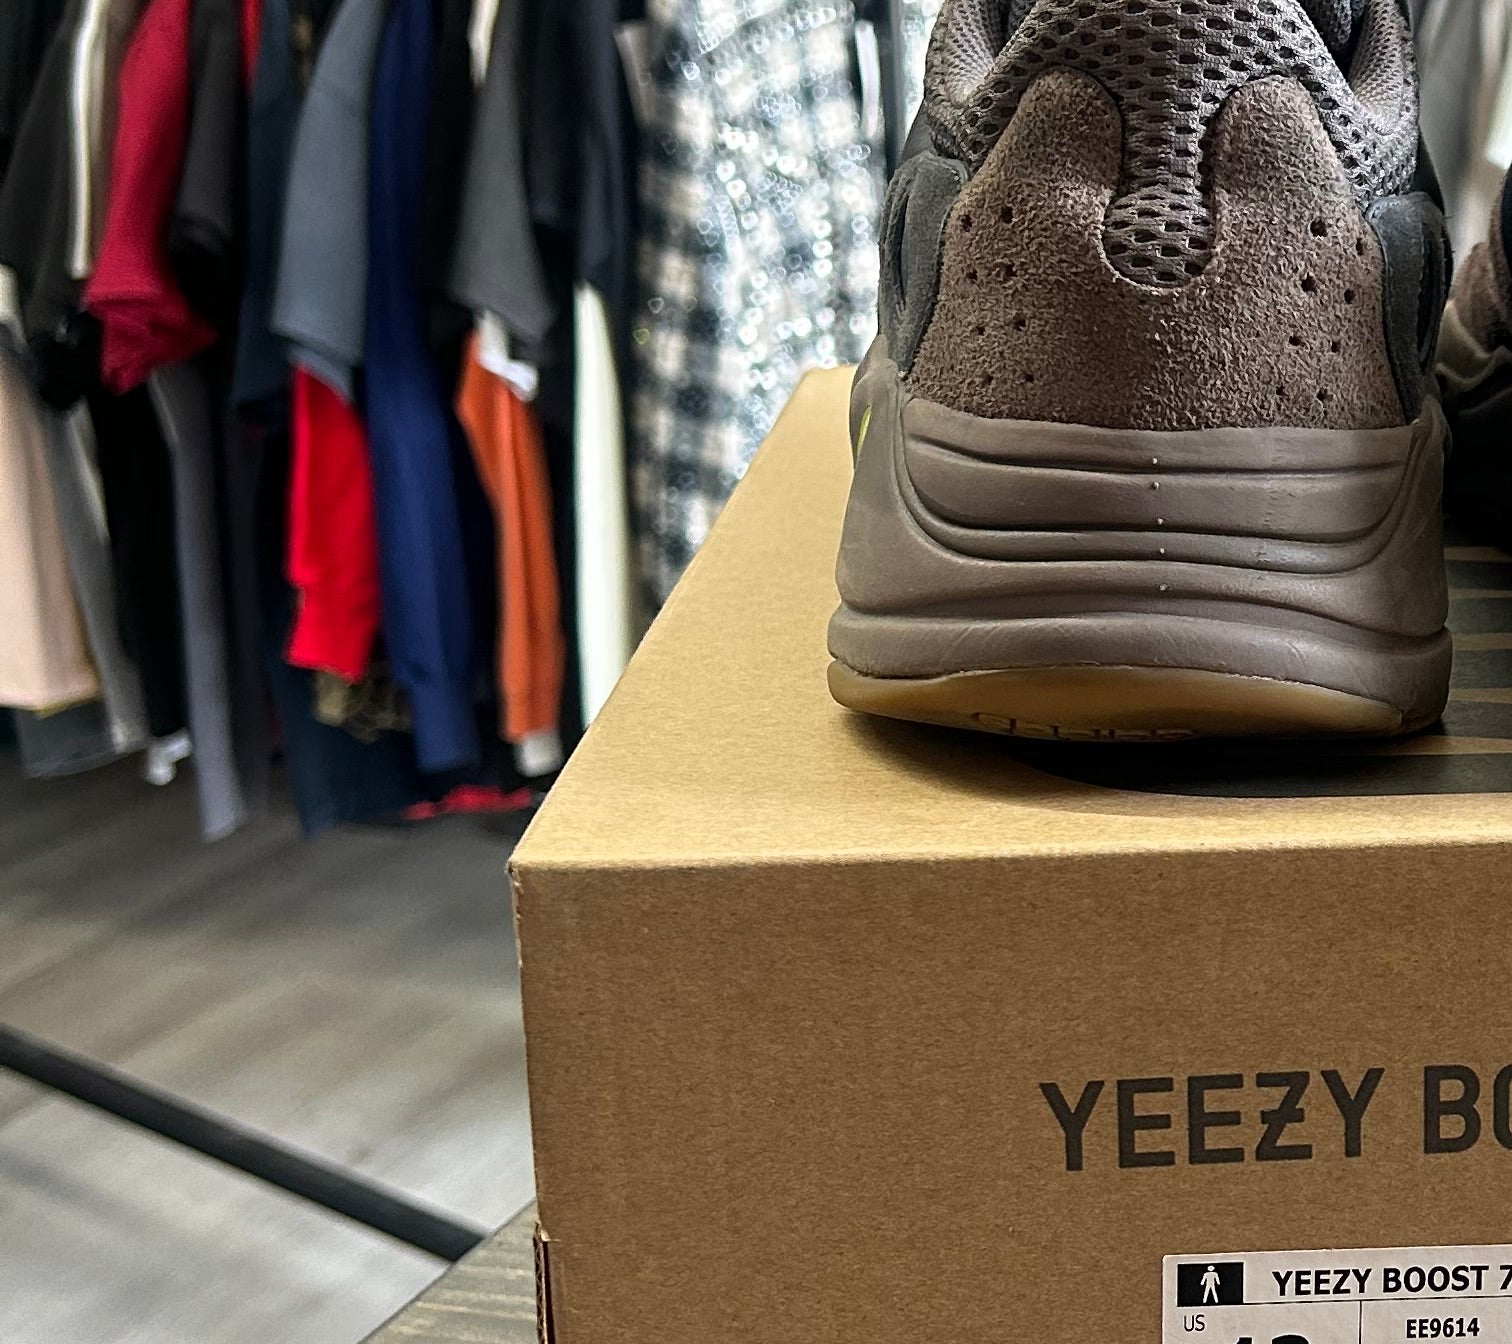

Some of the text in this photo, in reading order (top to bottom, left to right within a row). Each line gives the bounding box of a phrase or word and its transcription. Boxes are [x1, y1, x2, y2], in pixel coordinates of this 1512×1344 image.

[1039, 1068, 1385, 1172] YEEZY
[1272, 1268, 1372, 1296] YEEZY
[1383, 1264, 1489, 1293] BOOST
[1183, 1314, 1205, 1332] US
[1406, 1318, 1480, 1338] EE9614
